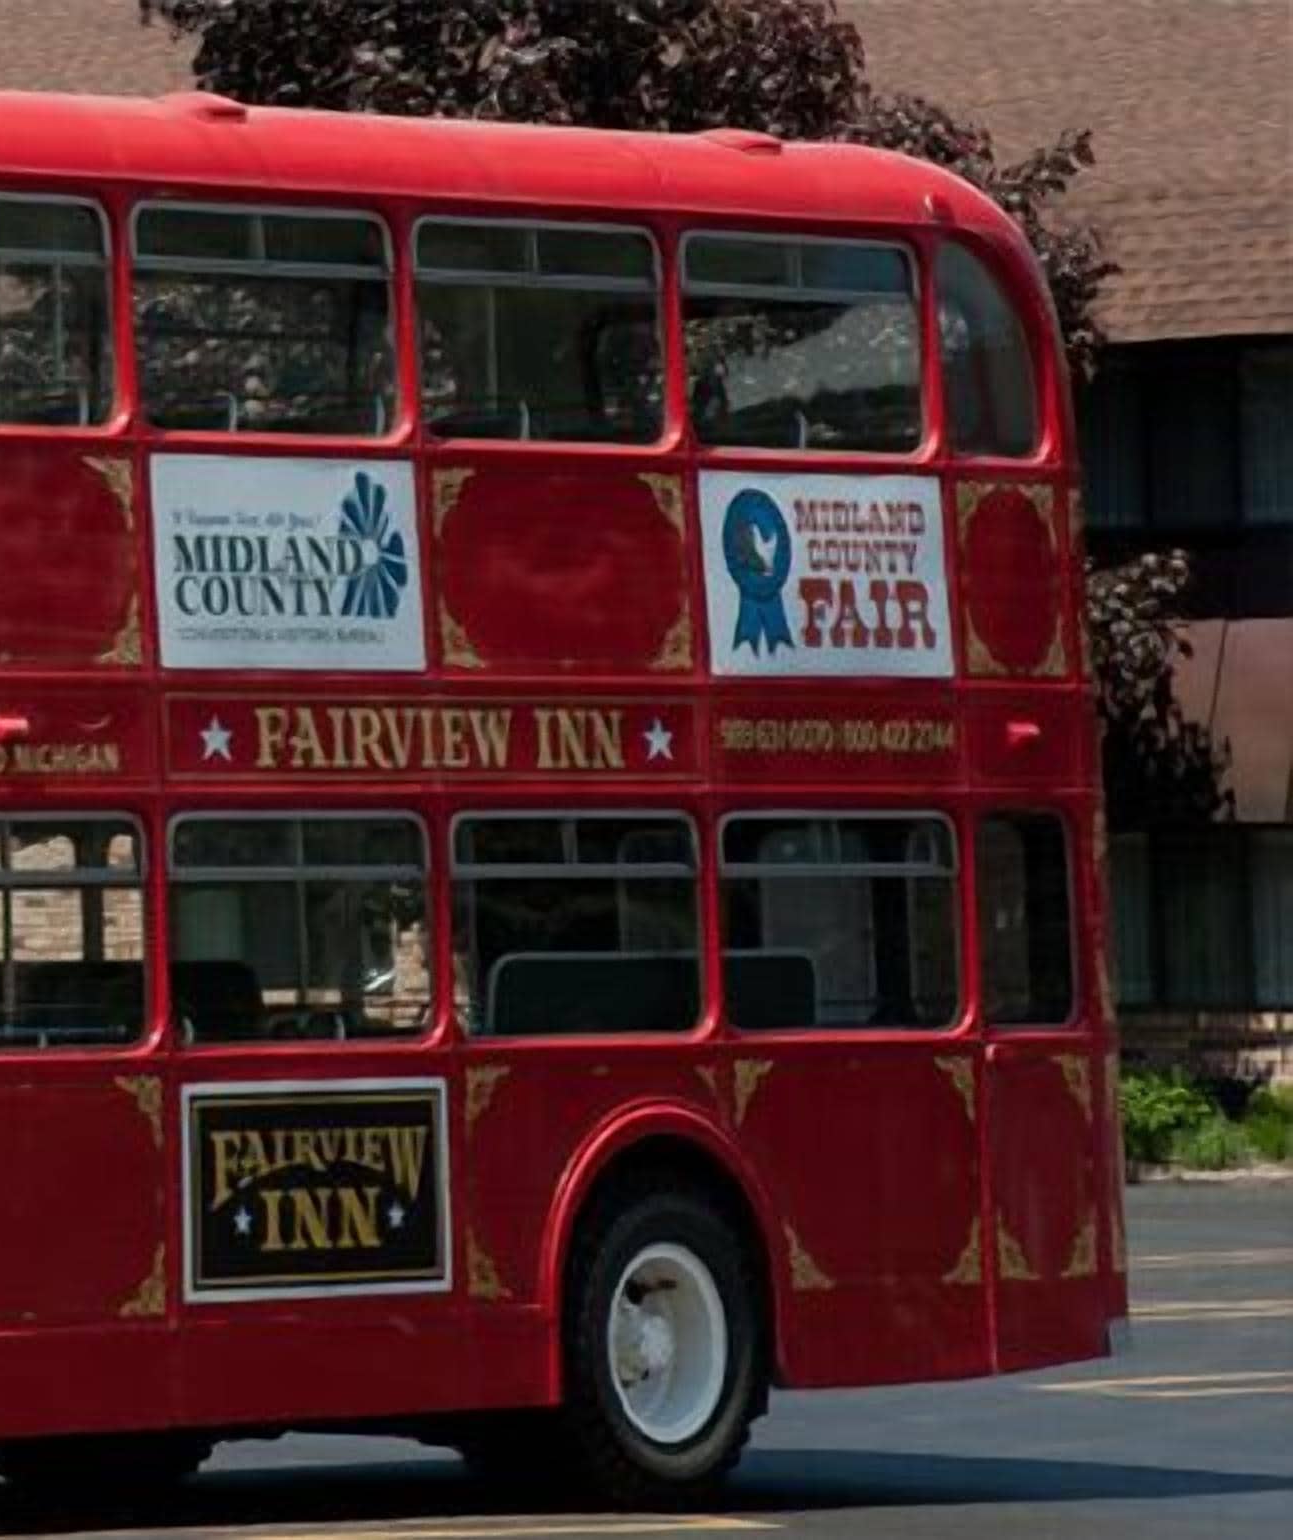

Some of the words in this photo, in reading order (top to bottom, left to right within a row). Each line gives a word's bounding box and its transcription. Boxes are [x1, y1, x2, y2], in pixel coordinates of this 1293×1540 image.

[793, 499, 926, 535] MIDLAND
[173, 535, 363, 576] MIDLAND
[807, 538, 917, 574] COUNTY
[174, 575, 338, 617] COUNTY
[798, 578, 937, 649] FAIR
[254, 707, 512, 770] FAIRVIEW
[534, 708, 626, 769] INN
[210, 1126, 429, 1211] FAIRVIEW
[260, 1187, 382, 1252] INN
